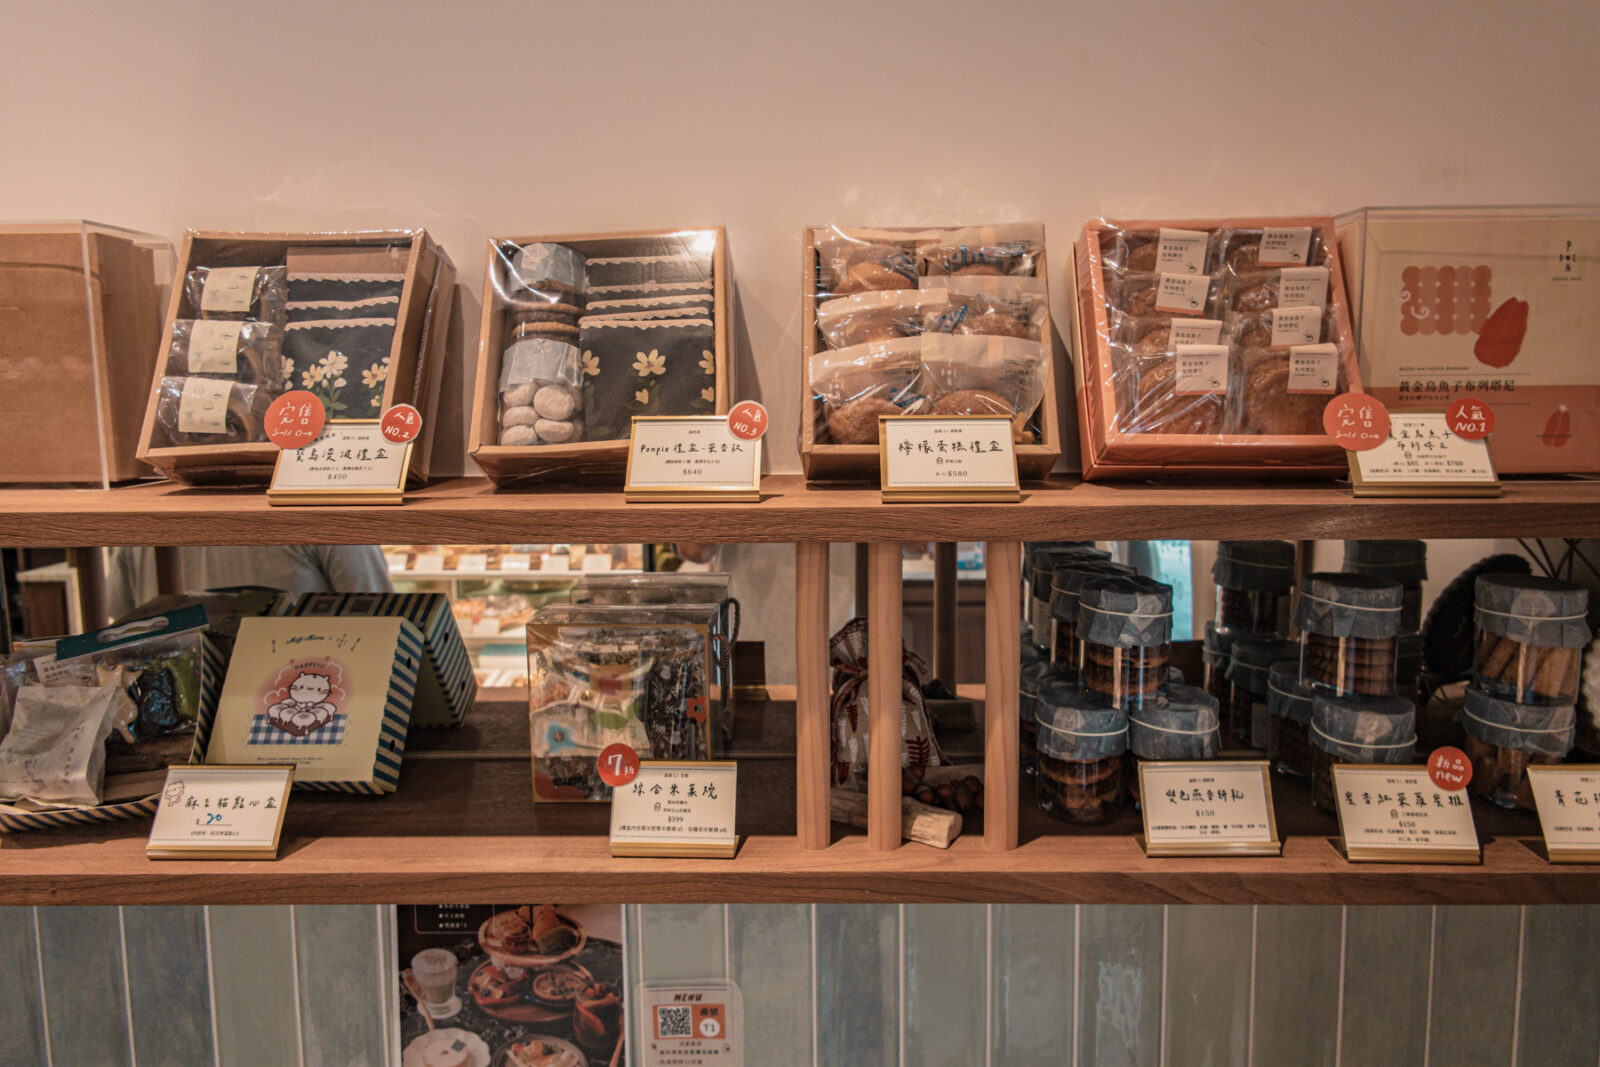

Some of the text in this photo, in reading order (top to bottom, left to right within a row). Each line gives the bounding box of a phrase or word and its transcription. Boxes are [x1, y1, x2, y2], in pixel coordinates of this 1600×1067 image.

[1399, 379, 1515, 393] 黃金烏魚子布列塔尼
[279, 401, 313, 425] 完售
[1337, 403, 1374, 428] 完售
[1455, 404, 1487, 421] 人氣
[898, 438, 1004, 456] 檸檬蛋糕禮盒
[674, 993, 703, 1002] MENU
